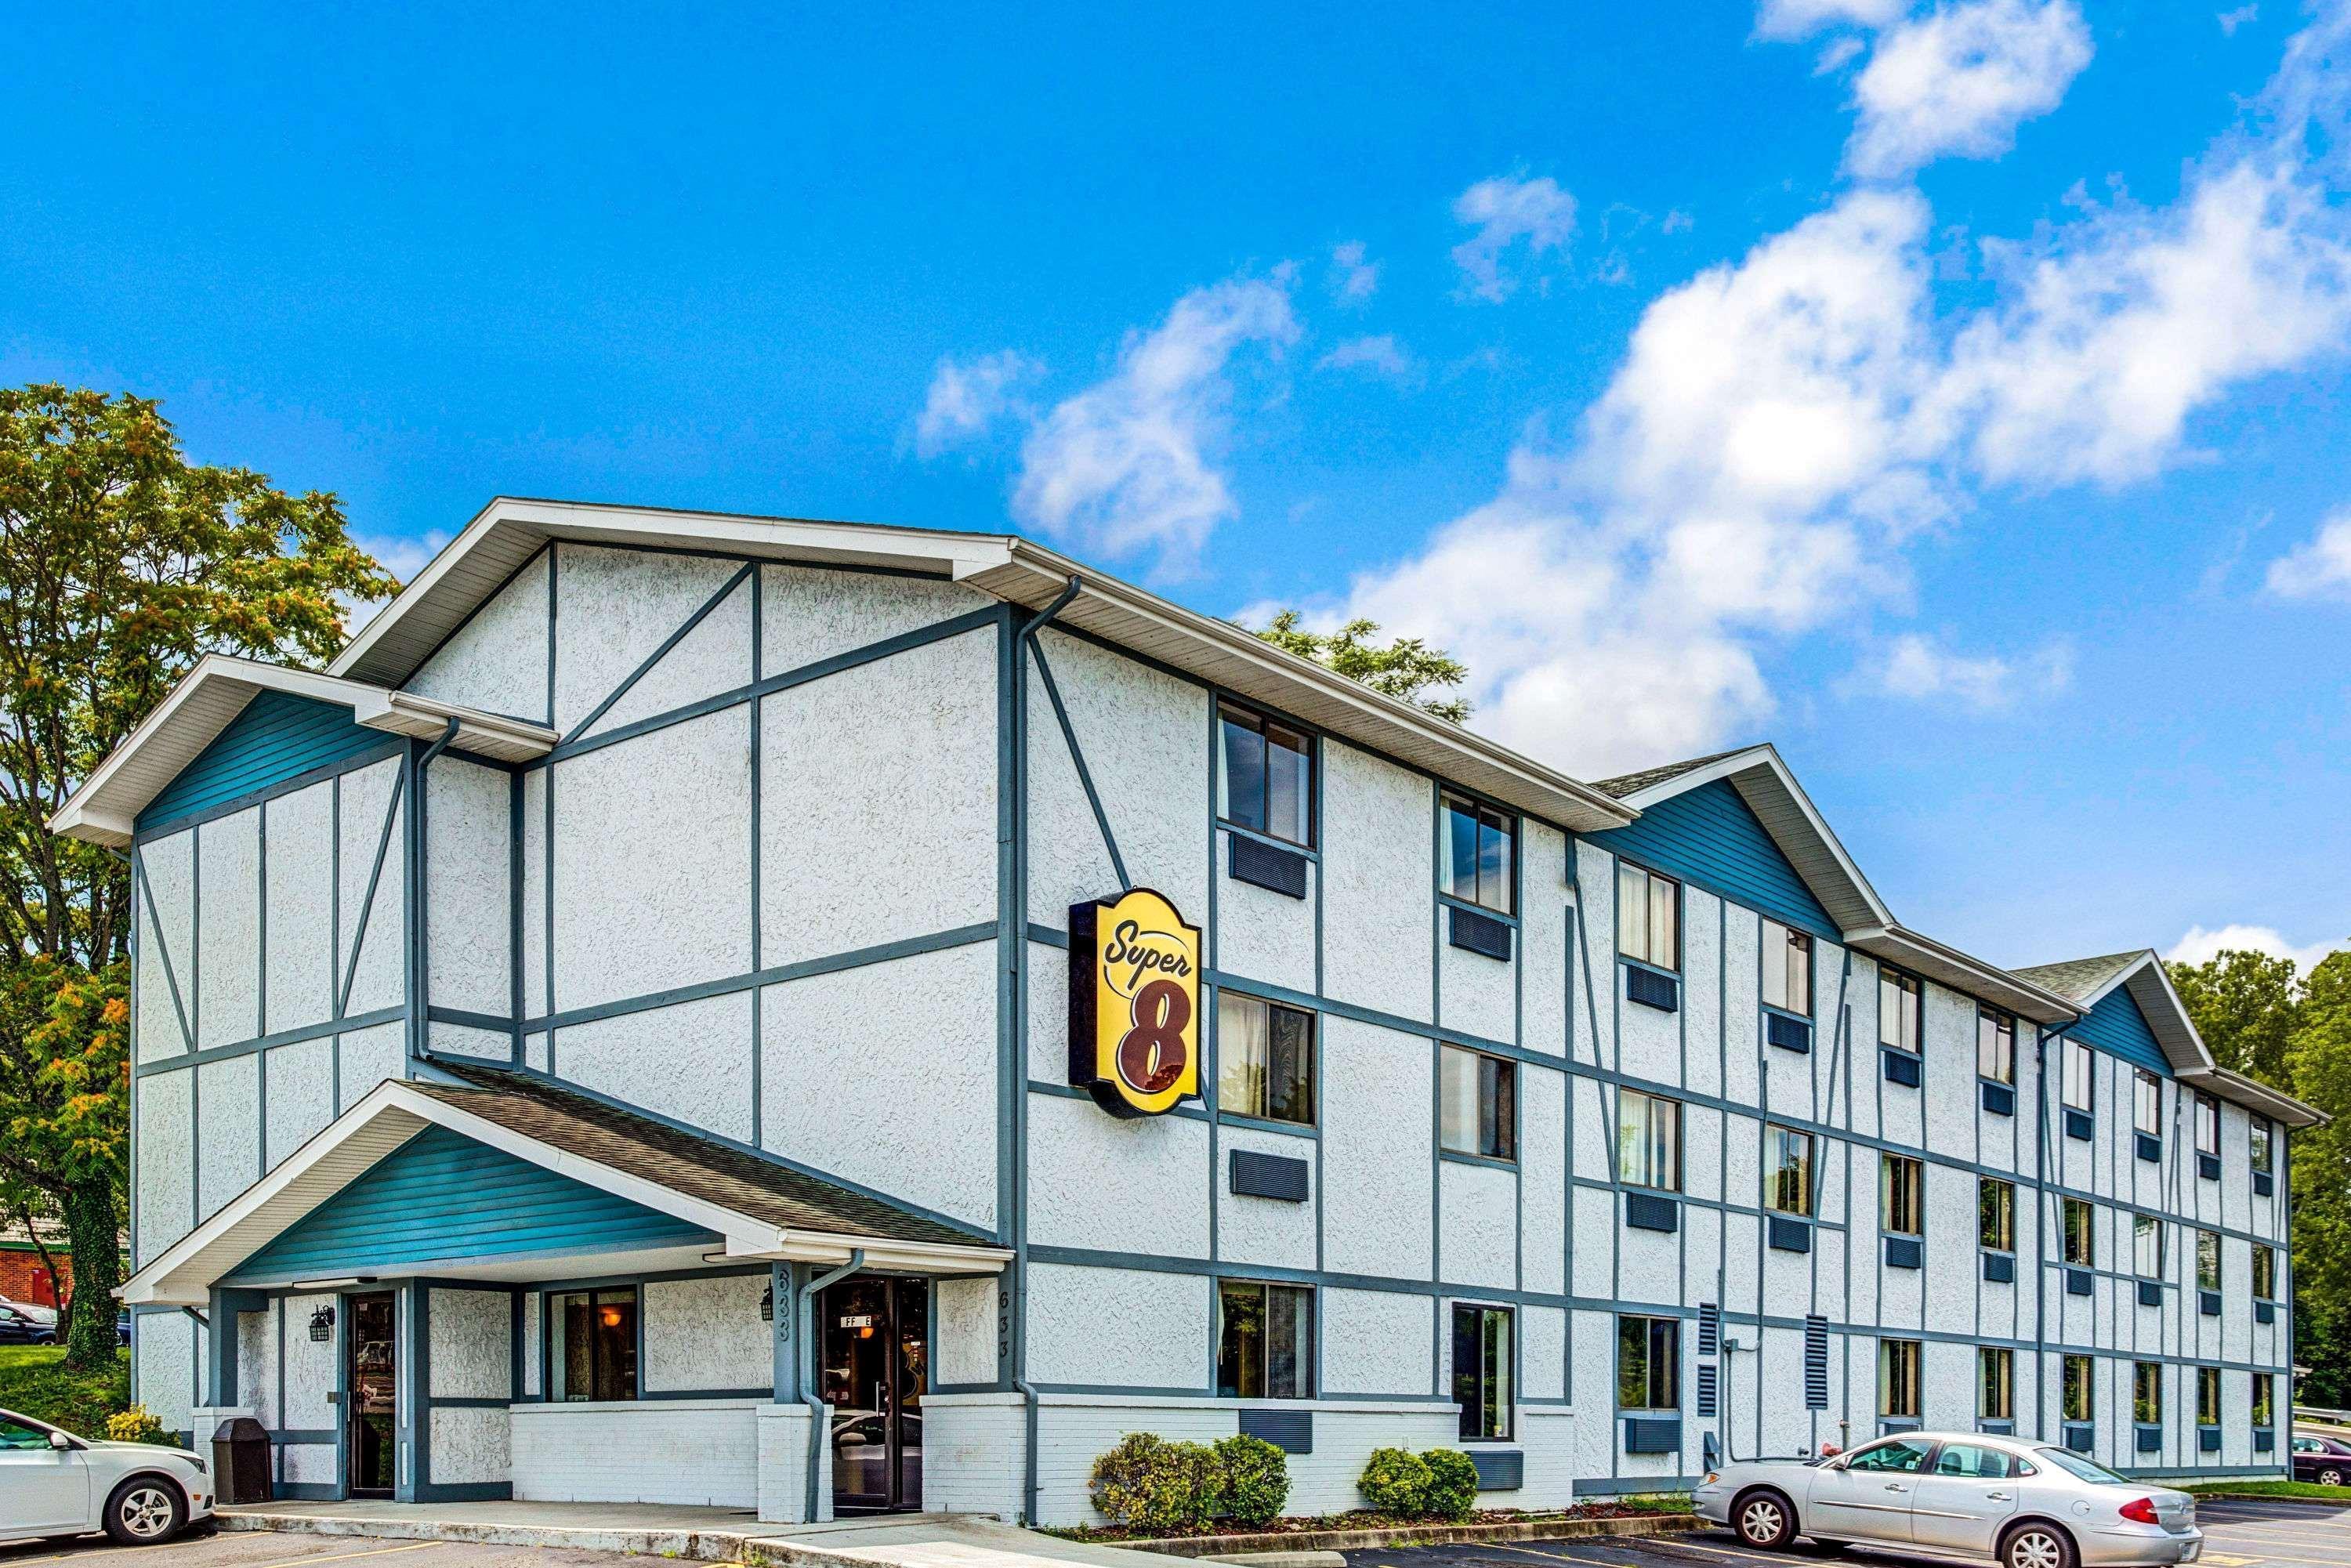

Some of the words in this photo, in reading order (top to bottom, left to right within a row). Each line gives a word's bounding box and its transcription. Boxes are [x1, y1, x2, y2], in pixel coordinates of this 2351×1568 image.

[1105, 919, 1191, 990] Super
[1116, 980, 1191, 1094] 8
[999, 1291, 1009, 1358] 633
